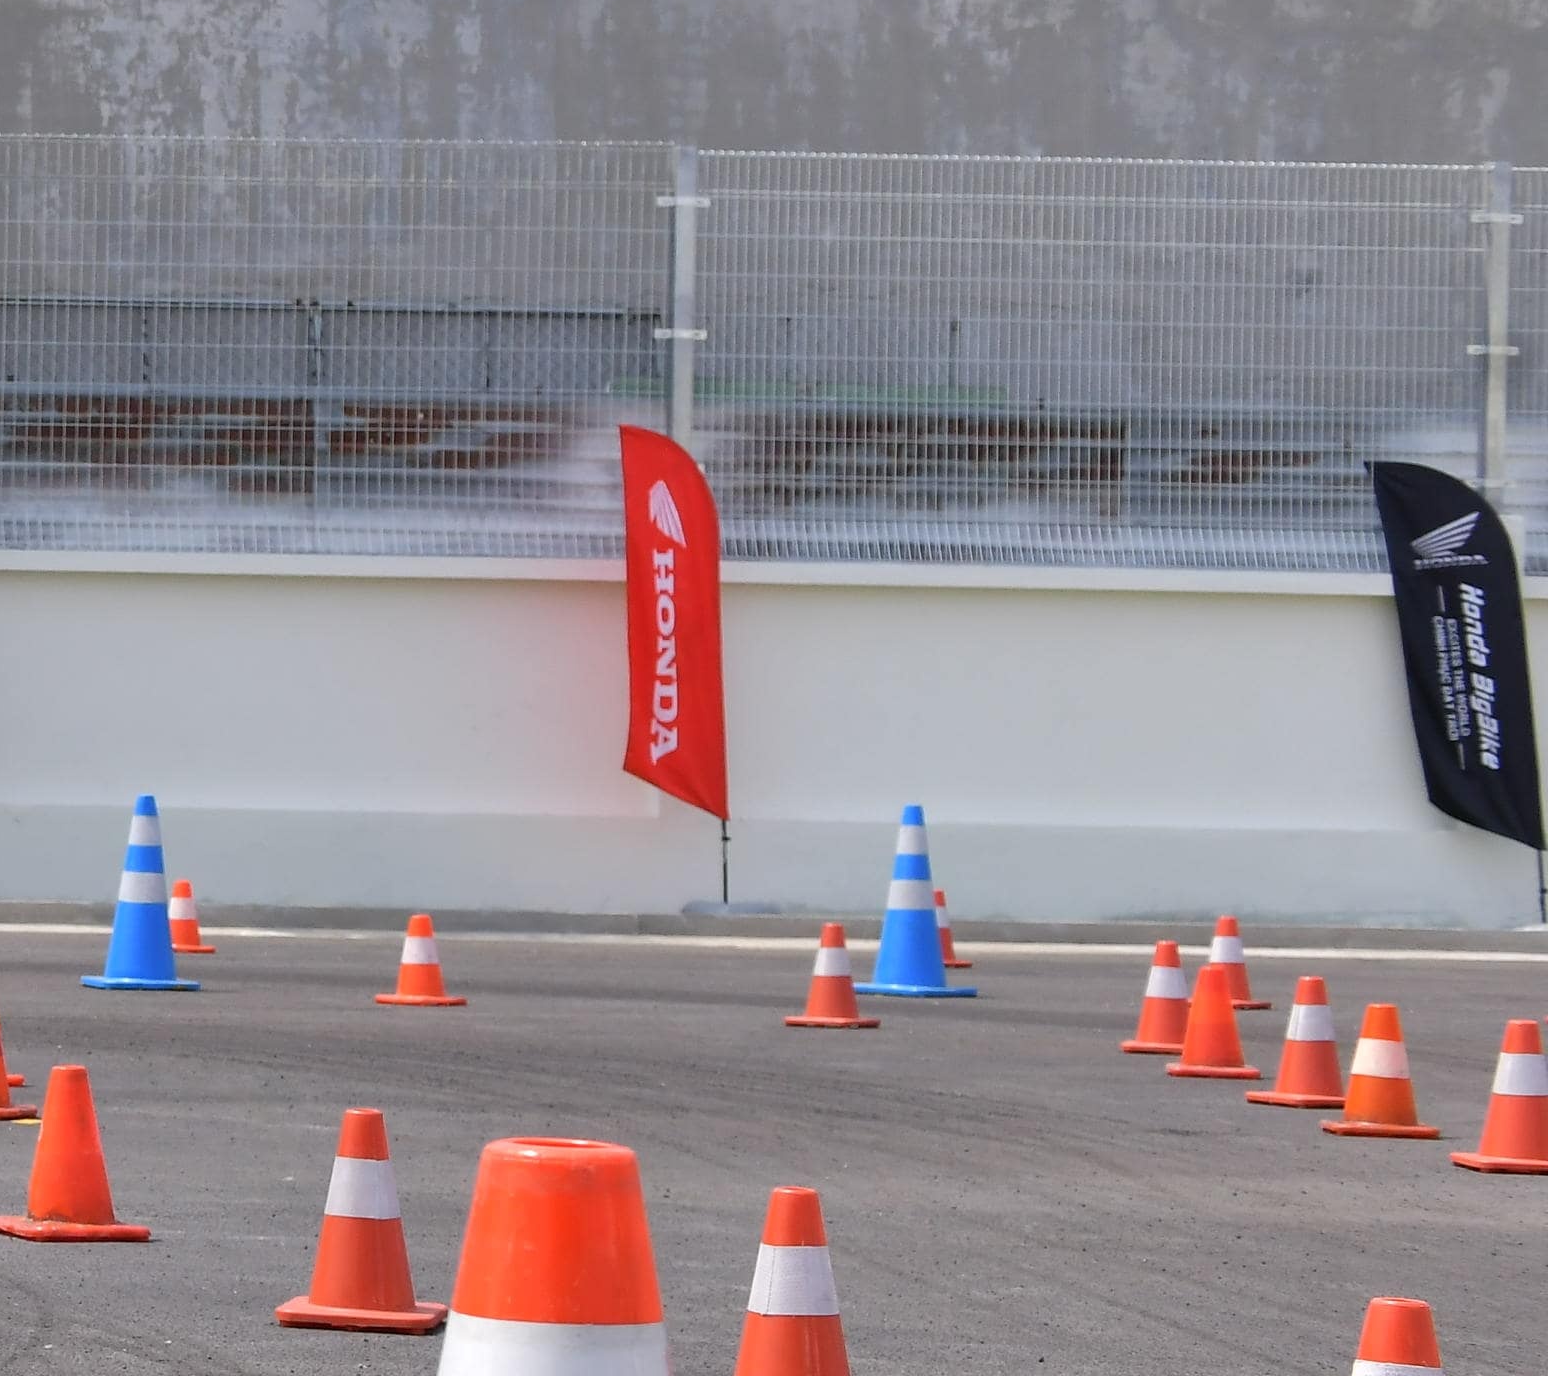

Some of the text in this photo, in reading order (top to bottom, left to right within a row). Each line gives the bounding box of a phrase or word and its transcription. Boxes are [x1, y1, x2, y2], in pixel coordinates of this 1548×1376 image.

[649, 549, 679, 765] HONDA
[1458, 582, 1501, 770] Honda BigBike
